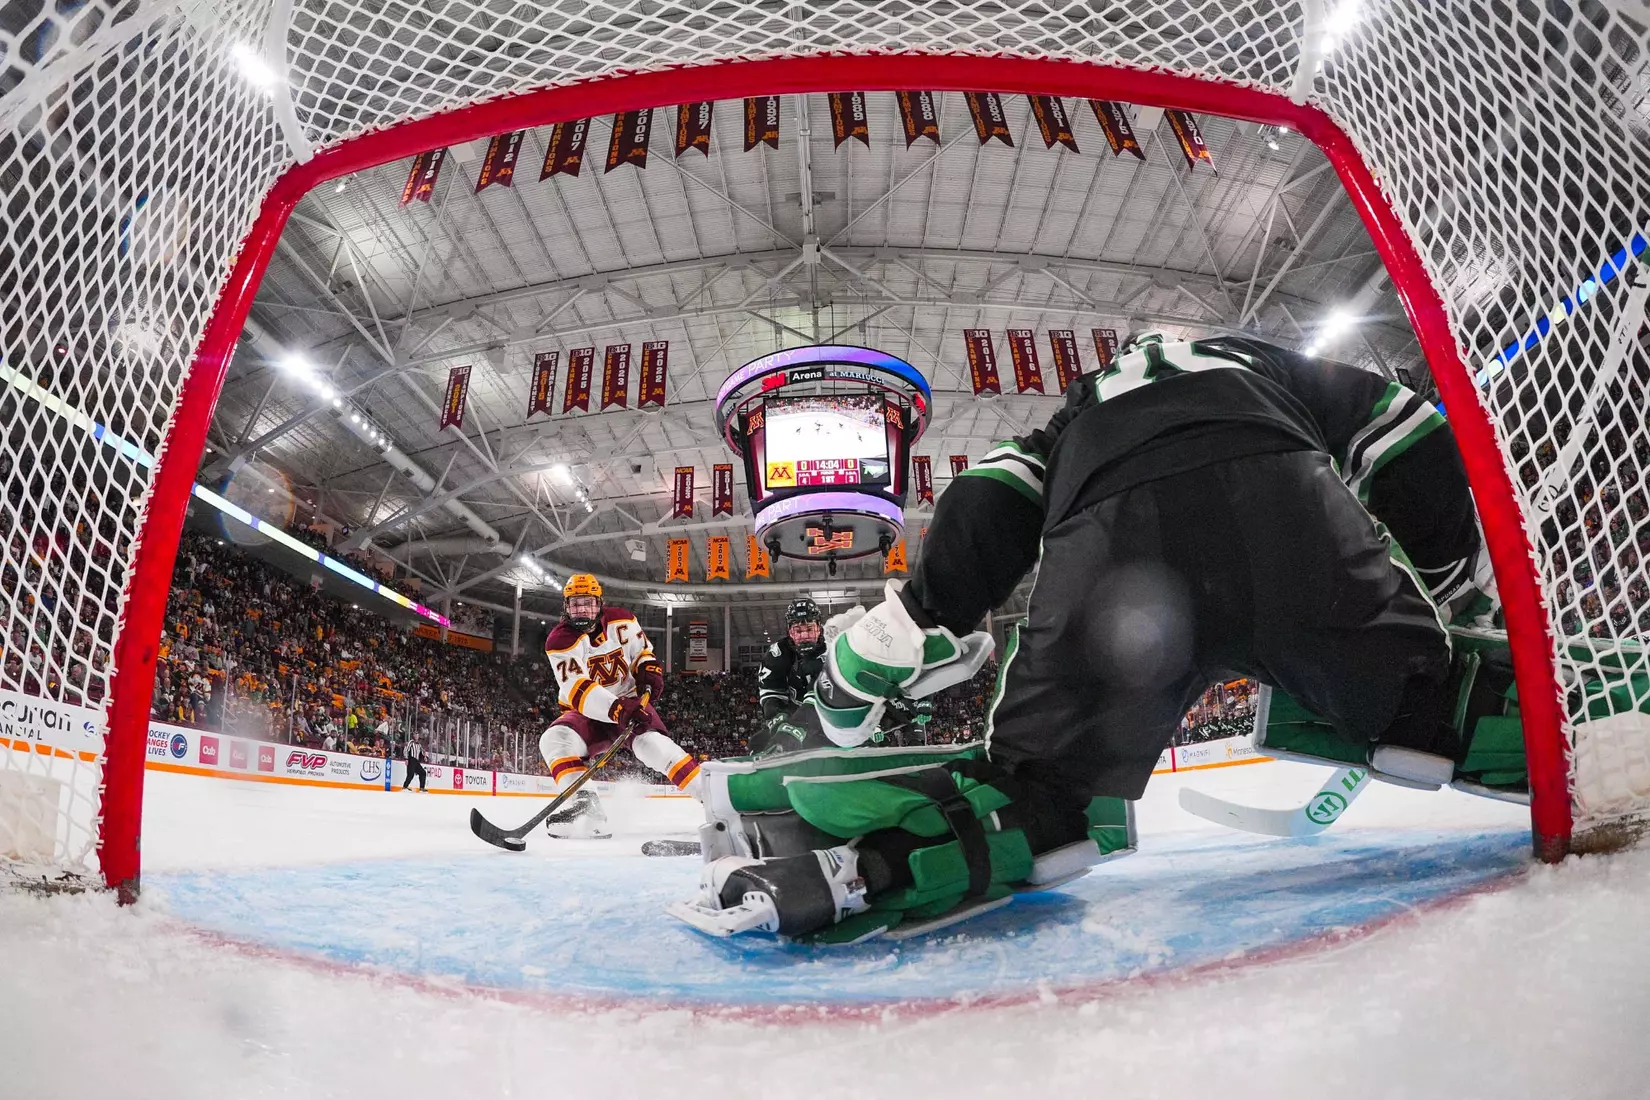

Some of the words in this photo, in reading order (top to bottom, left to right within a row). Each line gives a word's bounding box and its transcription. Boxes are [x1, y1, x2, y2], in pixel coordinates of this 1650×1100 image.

[634, 108, 648, 143] 2006
[617, 354, 626, 386] 2023
[655, 350, 664, 383] 2022
[747, 349, 796, 377] PARTY
[981, 339, 992, 371] 2017
[1024, 339, 1036, 371] 2016
[1065, 340, 1078, 372] 2015
[603, 353, 613, 403] CHAMPIONS
[640, 350, 650, 400] CHAMPIONS
[792, 371, 822, 381] Arena
[840, 371, 885, 385] MARIUCCI
[801, 460, 808, 470] 0
[815, 459, 840, 470] 14:04
[616, 624, 629, 645] C
[556, 657, 583, 683] 74
[286, 750, 328, 770] FVP
[362, 759, 380, 774] CHS
[465, 775, 487, 786] TOYOTA
